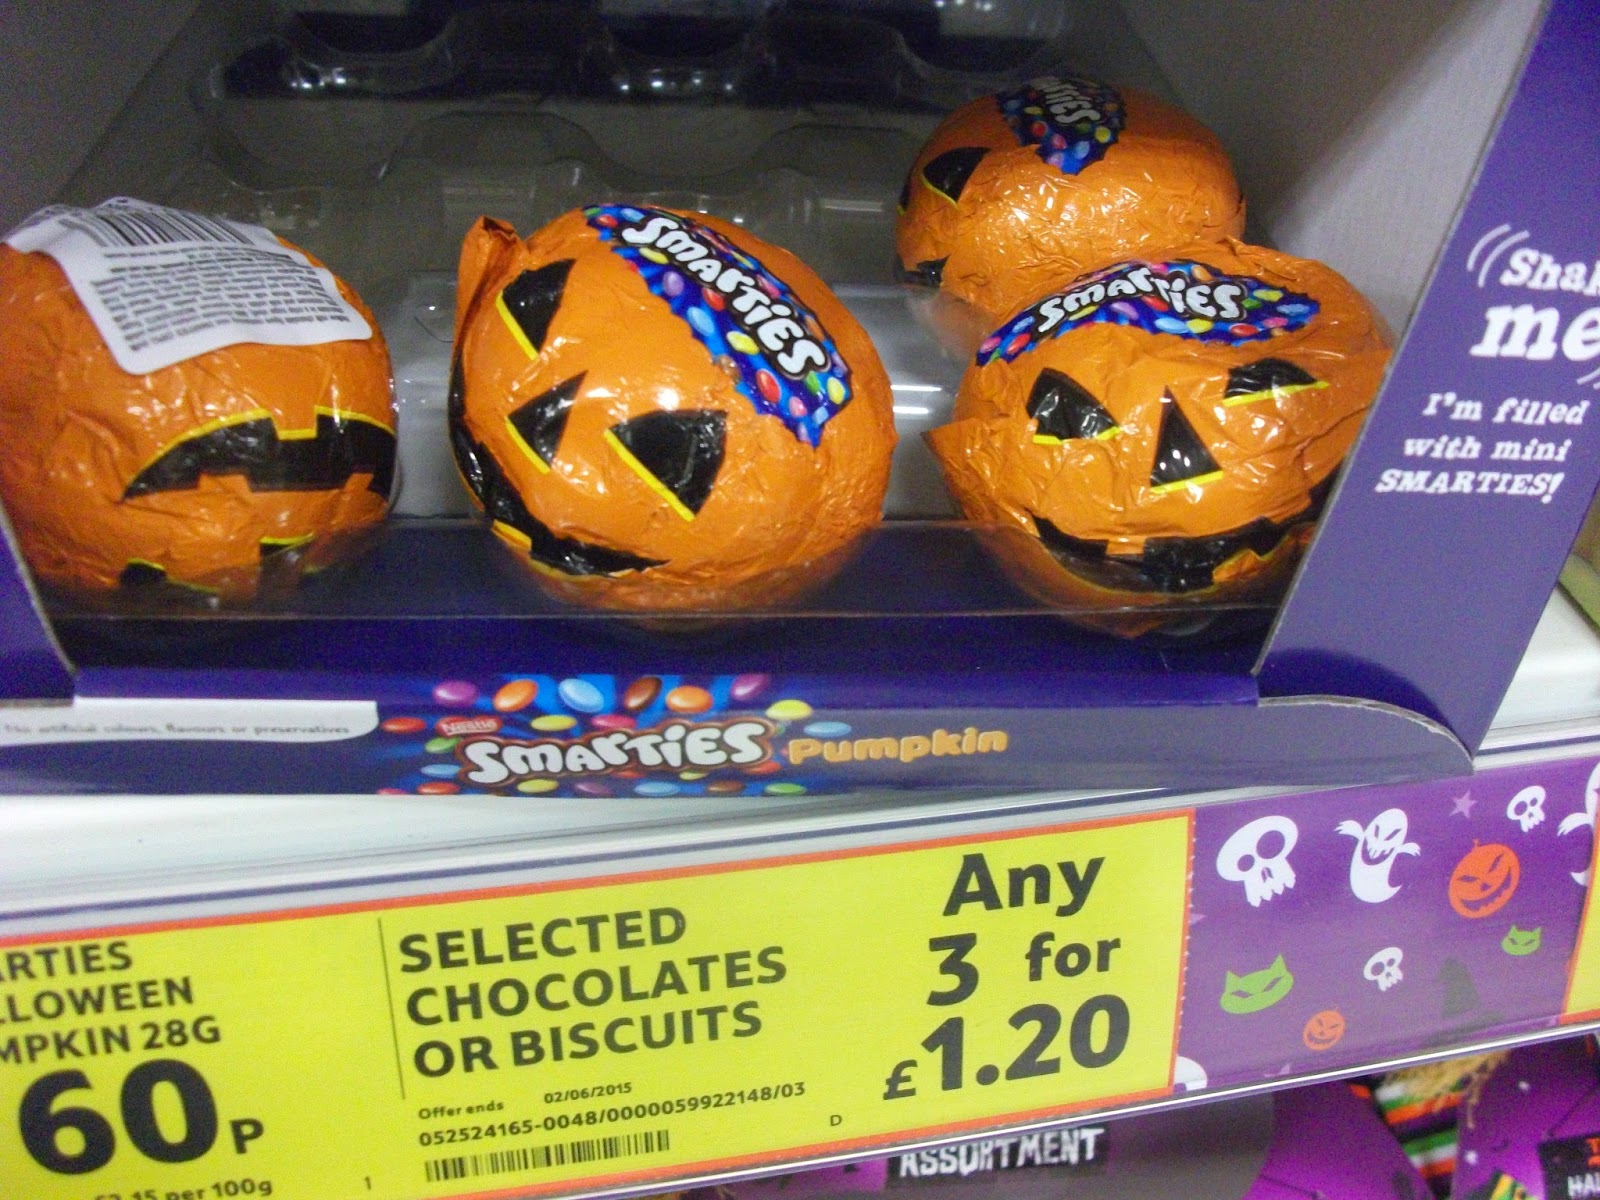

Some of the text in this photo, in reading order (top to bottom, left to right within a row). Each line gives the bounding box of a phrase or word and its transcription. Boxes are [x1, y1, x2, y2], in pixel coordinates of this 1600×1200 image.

[1469, 303, 1600, 361] me
[1422, 392, 1590, 425] I'm filled
[1403, 435, 1572, 462] with mini
[1375, 468, 1565, 504] SMARTIES!
[788, 727, 1008, 765] Pumpkin
[942, 852, 1106, 917] Any
[0, 940, 133, 982] RTIES
[400, 907, 686, 973] SELECTED
[407, 946, 787, 1026] CHOCOLATES
[926, 931, 1121, 1006] 3 for
[0, 976, 194, 1024] LOWEEN
[140, 1015, 221, 1051] 28G
[414, 1000, 762, 1078] OR BISCUITS
[883, 994, 1130, 1100] £1.20
[418, 1081, 633, 1121] Offer ends 02/06/2015
[211, 1178, 273, 1197] 100g
